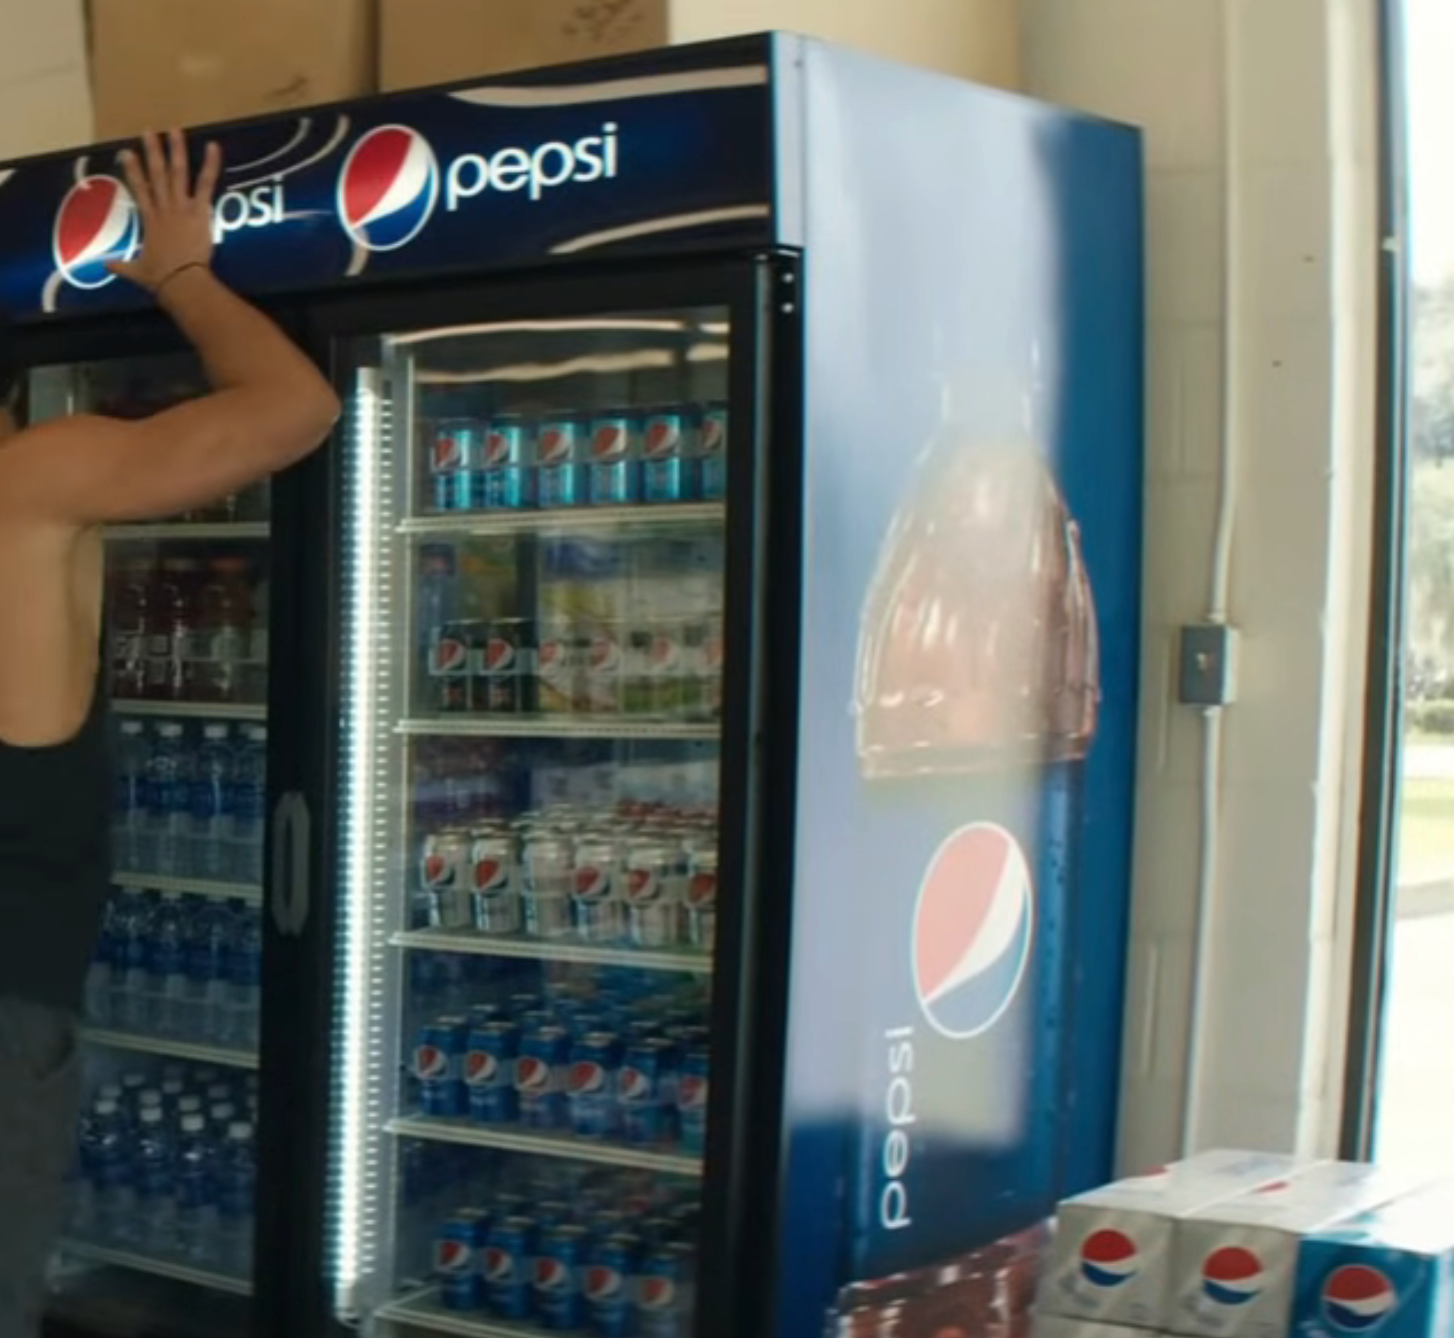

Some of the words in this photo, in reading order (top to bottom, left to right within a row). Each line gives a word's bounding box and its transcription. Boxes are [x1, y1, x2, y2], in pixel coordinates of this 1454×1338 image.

[212, 173, 285, 245] psi
[445, 122, 619, 212] pepsi
[880, 1025, 917, 1230] pepsi
